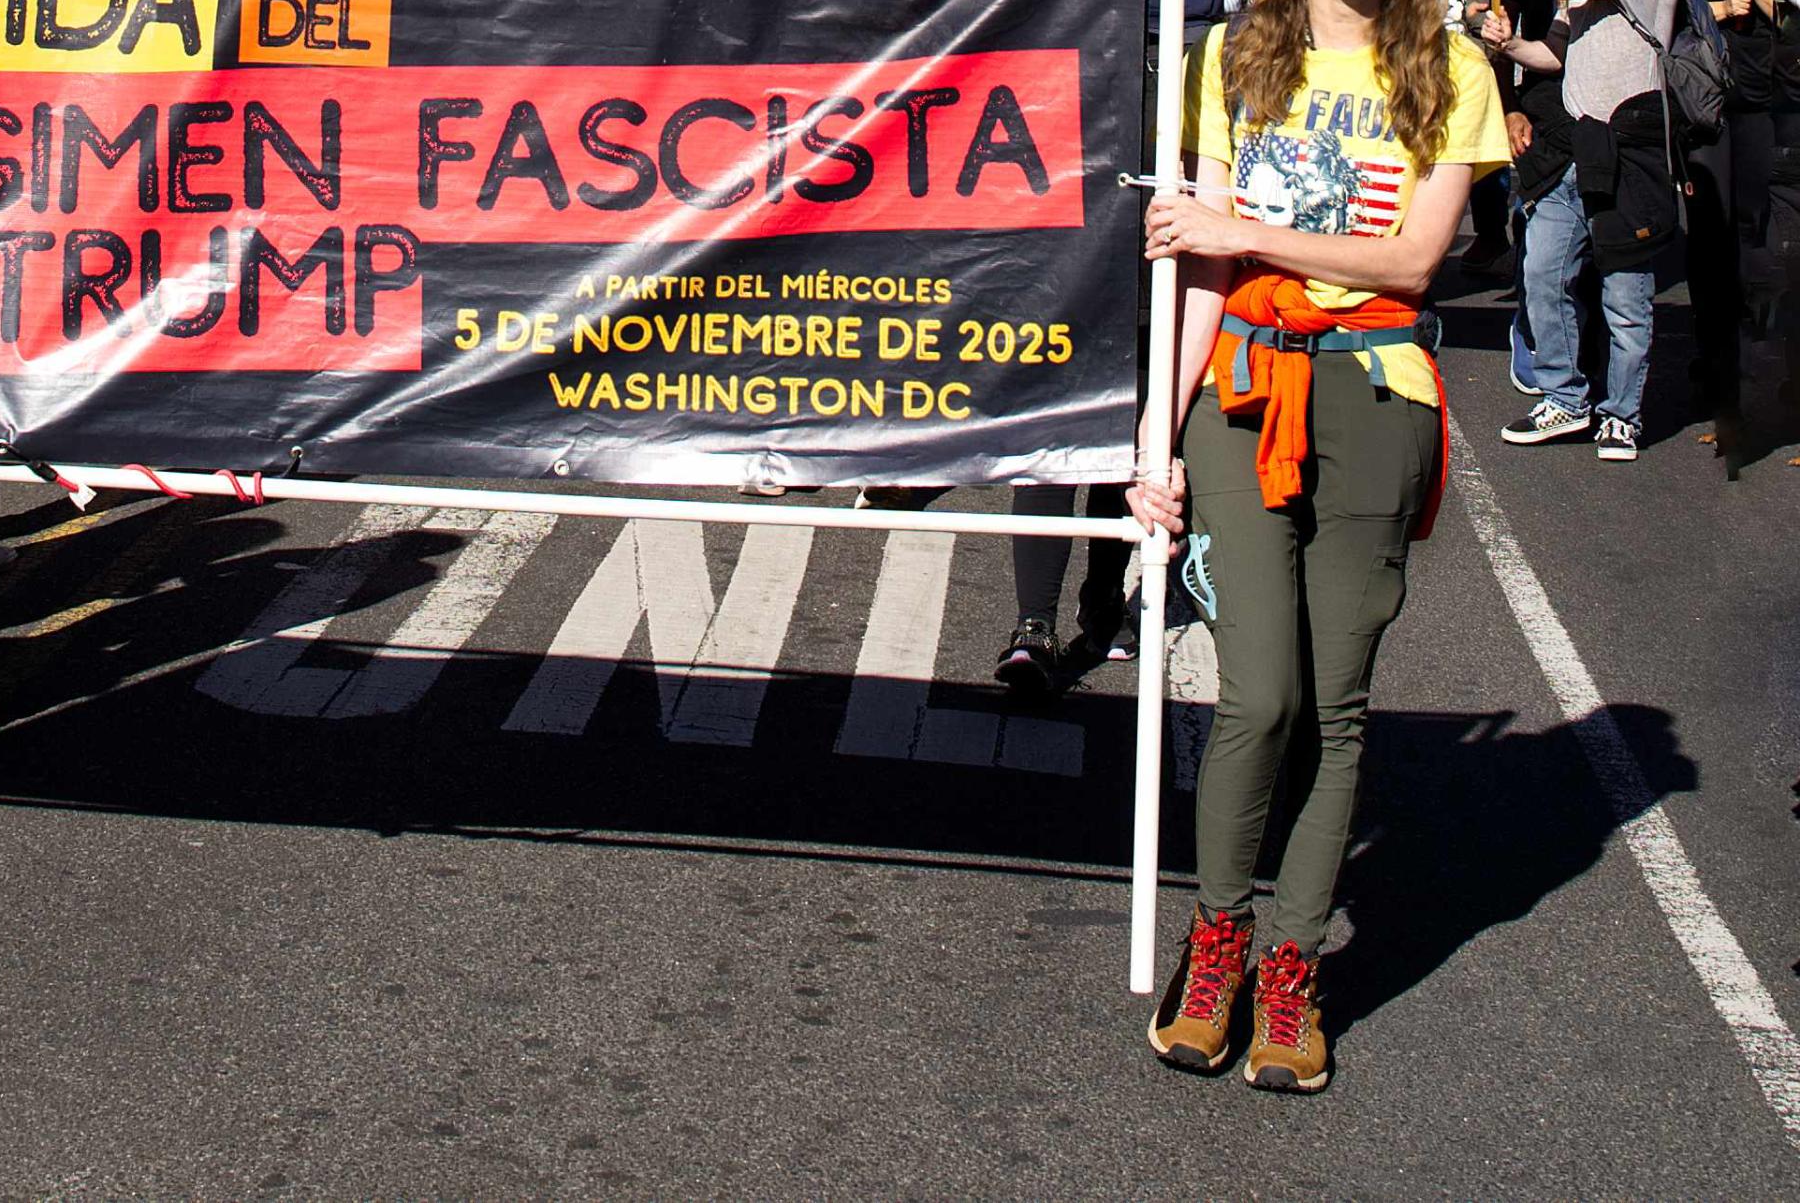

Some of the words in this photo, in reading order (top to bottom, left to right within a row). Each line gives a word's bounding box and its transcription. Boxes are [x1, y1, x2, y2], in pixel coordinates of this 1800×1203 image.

[417, 84, 1051, 213] FASCISTA
[575, 276, 595, 299] A
[606, 276, 705, 301] PARTIR
[715, 274, 771, 300] DEL
[781, 268, 953, 305] MIÉRCOLES
[455, 309, 480, 351] 5
[496, 310, 558, 354] DE
[573, 313, 862, 360] NOVIEMBRE
[877, 318, 942, 362] DE
[958, 320, 1074, 365] 2025
[547, 372, 884, 418] WASHINGTON
[903, 381, 972, 421] DC
